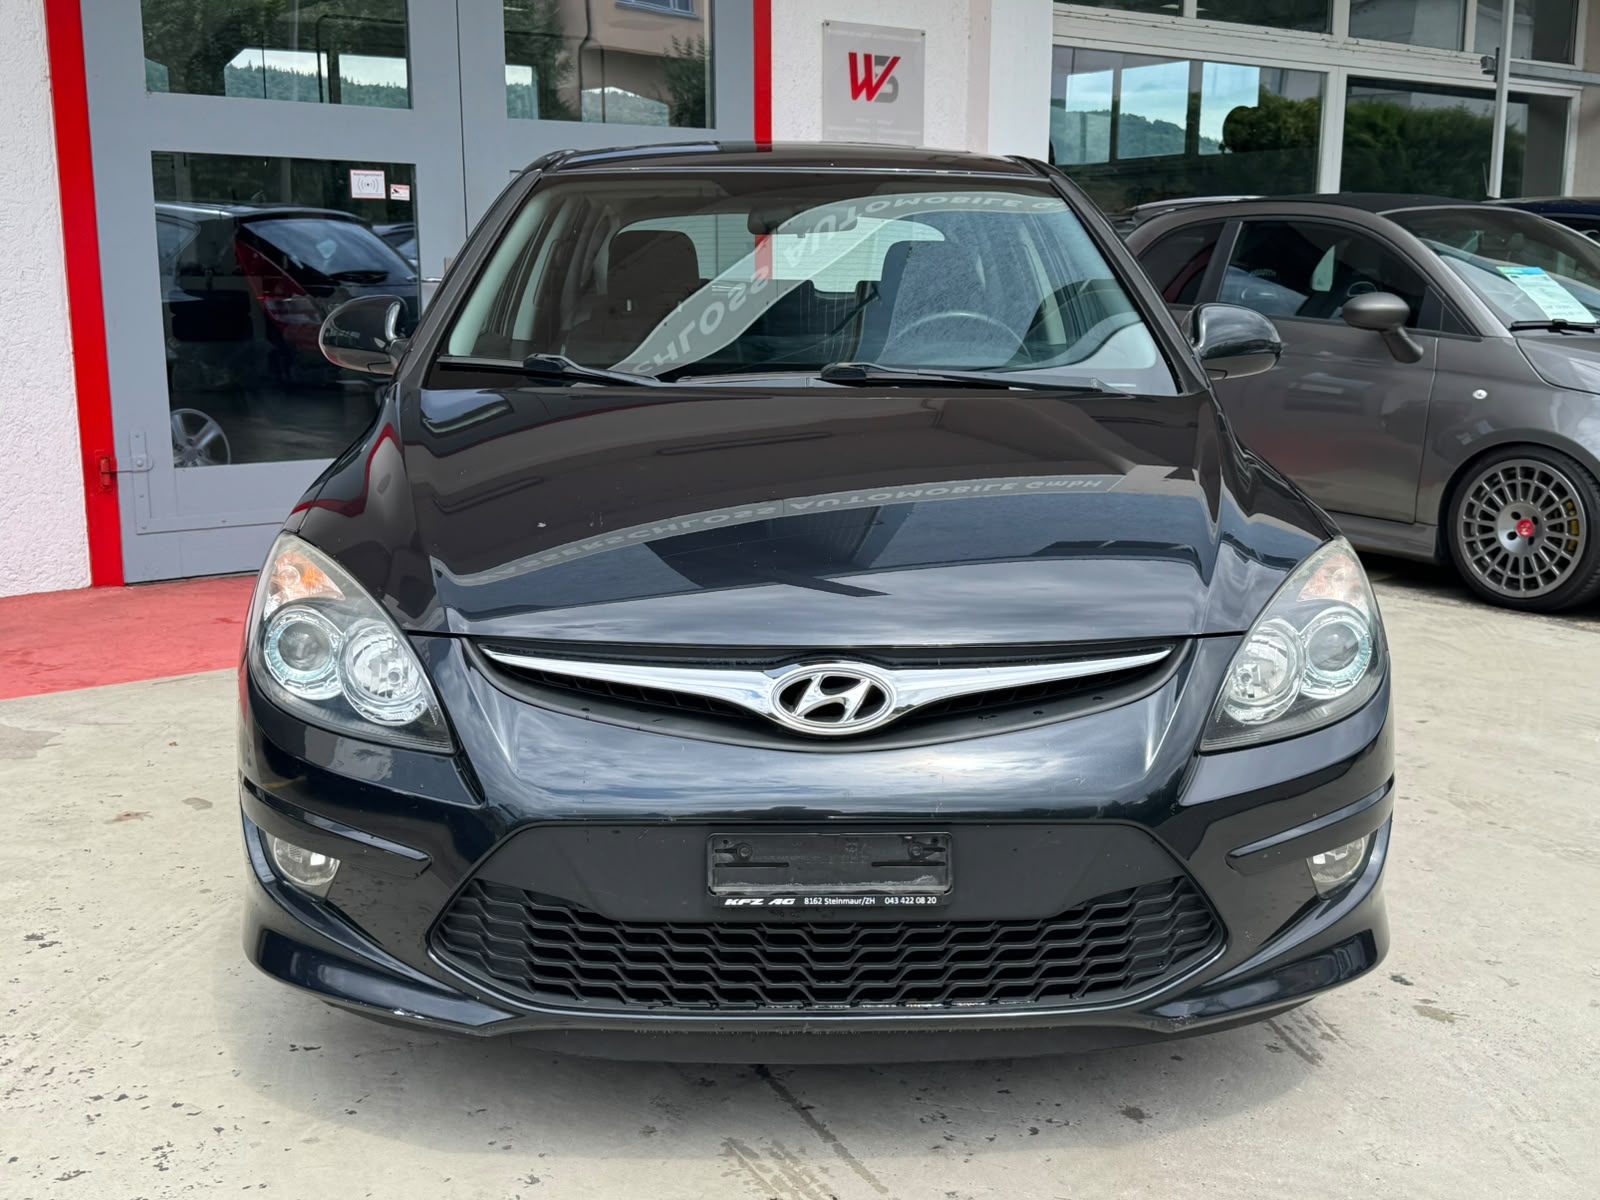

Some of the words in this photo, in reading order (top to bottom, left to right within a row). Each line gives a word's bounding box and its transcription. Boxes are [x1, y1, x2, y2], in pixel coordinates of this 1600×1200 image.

[724, 898, 764, 906] KFZ
[768, 898, 796, 906] AG
[803, 897, 823, 905] 8162
[824, 897, 876, 906] Steinmaur/ZH
[884, 897, 899, 905] 043
[900, 897, 914, 905] 422
[915, 897, 926, 905] 08
[926, 896, 937, 905] 20
